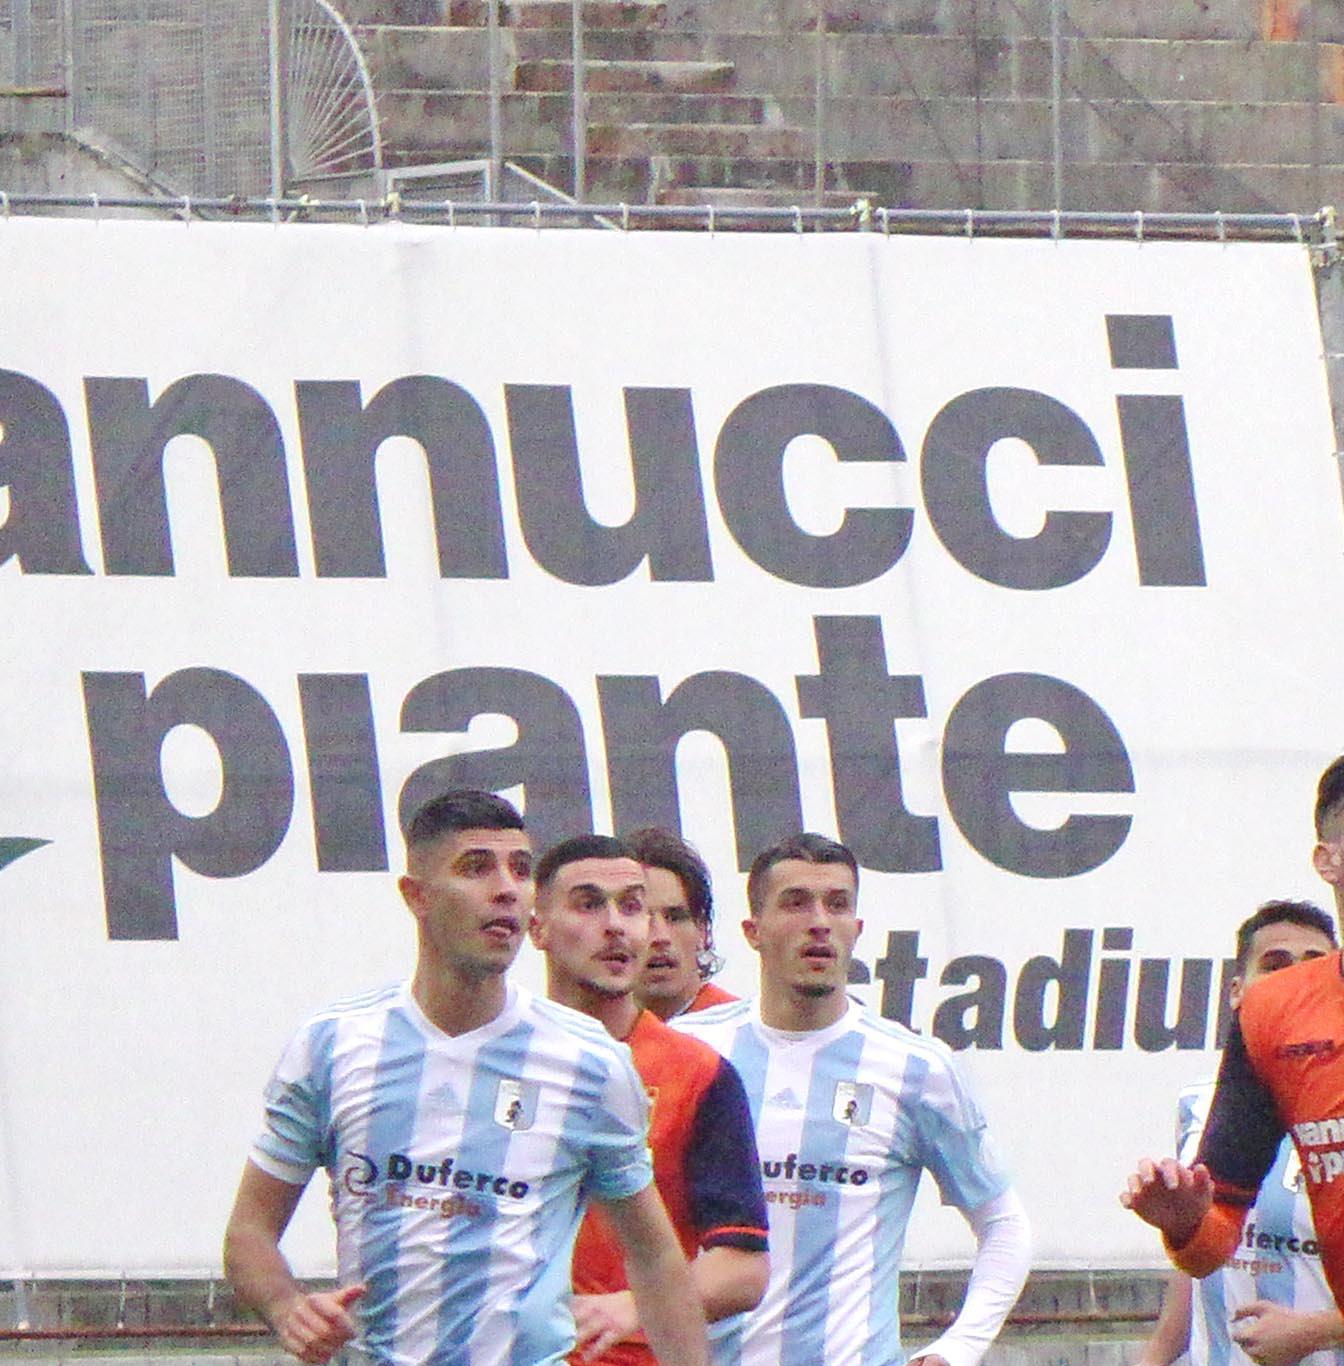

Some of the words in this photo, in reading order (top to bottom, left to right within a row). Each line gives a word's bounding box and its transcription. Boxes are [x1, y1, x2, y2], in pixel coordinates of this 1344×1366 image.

[82, 616, 1135, 942] piante
[847, 927, 1240, 1053] tadiu
[387, 1152, 529, 1200] Duferco
